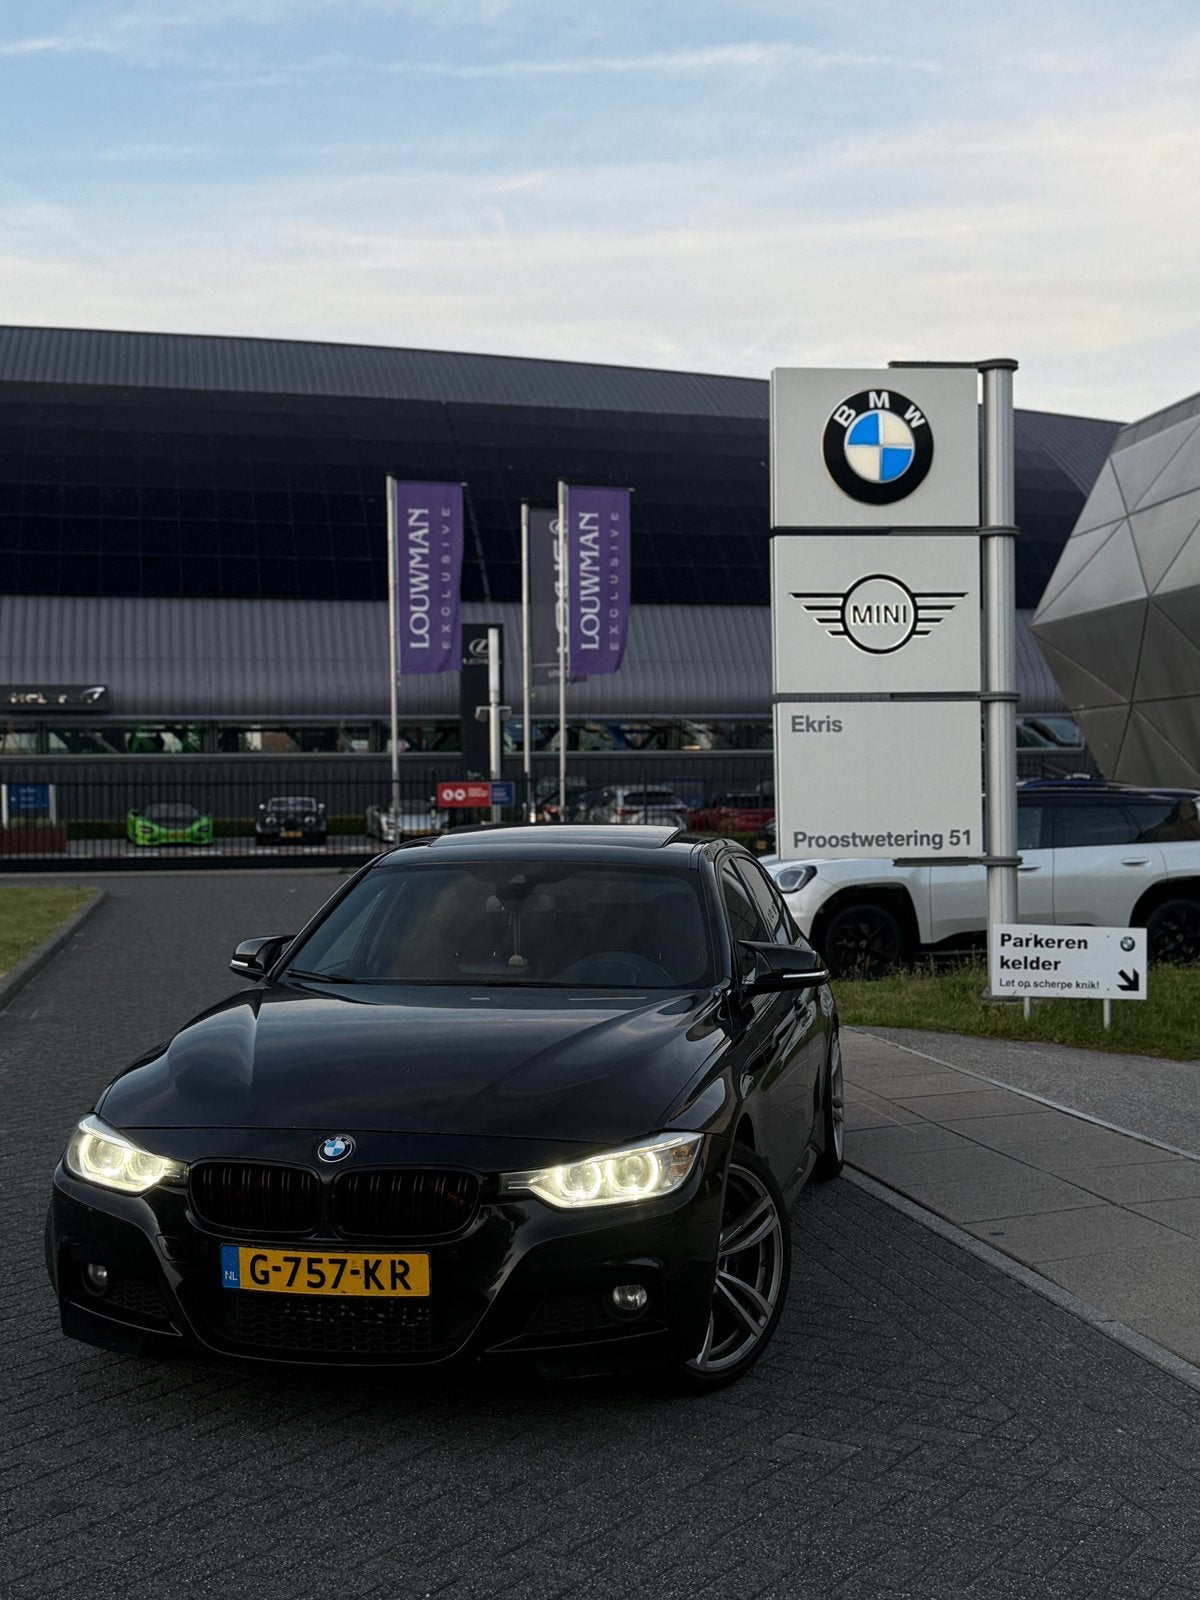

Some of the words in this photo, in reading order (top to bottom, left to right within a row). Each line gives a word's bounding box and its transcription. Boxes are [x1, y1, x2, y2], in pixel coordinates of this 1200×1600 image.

[833, 391, 926, 428] BMW
[408, 507, 430, 649] LOUWMAN
[441, 508, 451, 650] EXCLUSIVE
[579, 512, 601, 650] LOUWMAN
[609, 512, 620, 651] EXCLUSIVE
[852, 605, 907, 625] MINI
[791, 715, 843, 733] Ekris
[793, 830, 943, 850] Proostwetering
[949, 829, 971, 846] 51
[1001, 933, 1088, 949] Parkeren
[1001, 956, 1061, 970] kelder
[1000, 979, 1015, 987] Let
[1018, 980, 1030, 988] op
[1033, 980, 1073, 990] scherpe
[1076, 980, 1100, 990] knik!
[224, 1270, 238, 1281] NL
[250, 1254, 412, 1291] G-757-KR
